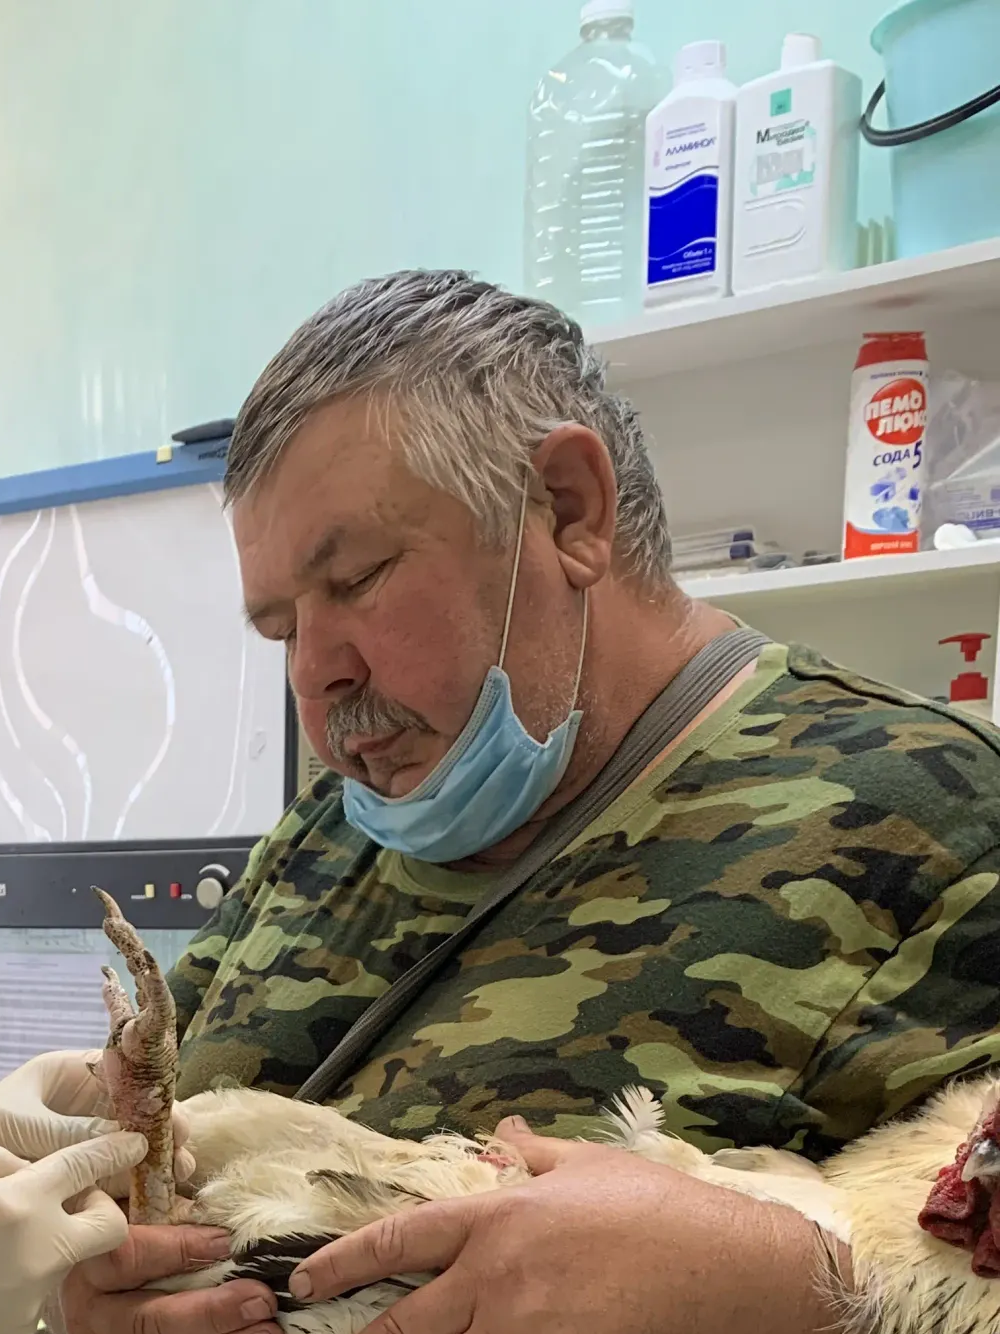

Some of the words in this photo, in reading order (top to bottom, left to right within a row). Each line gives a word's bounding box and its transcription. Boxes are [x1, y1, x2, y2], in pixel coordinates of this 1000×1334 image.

[864, 389, 923, 421] ПЕМО
[873, 448, 911, 467] СОДА
[912, 440, 922, 470] 5
